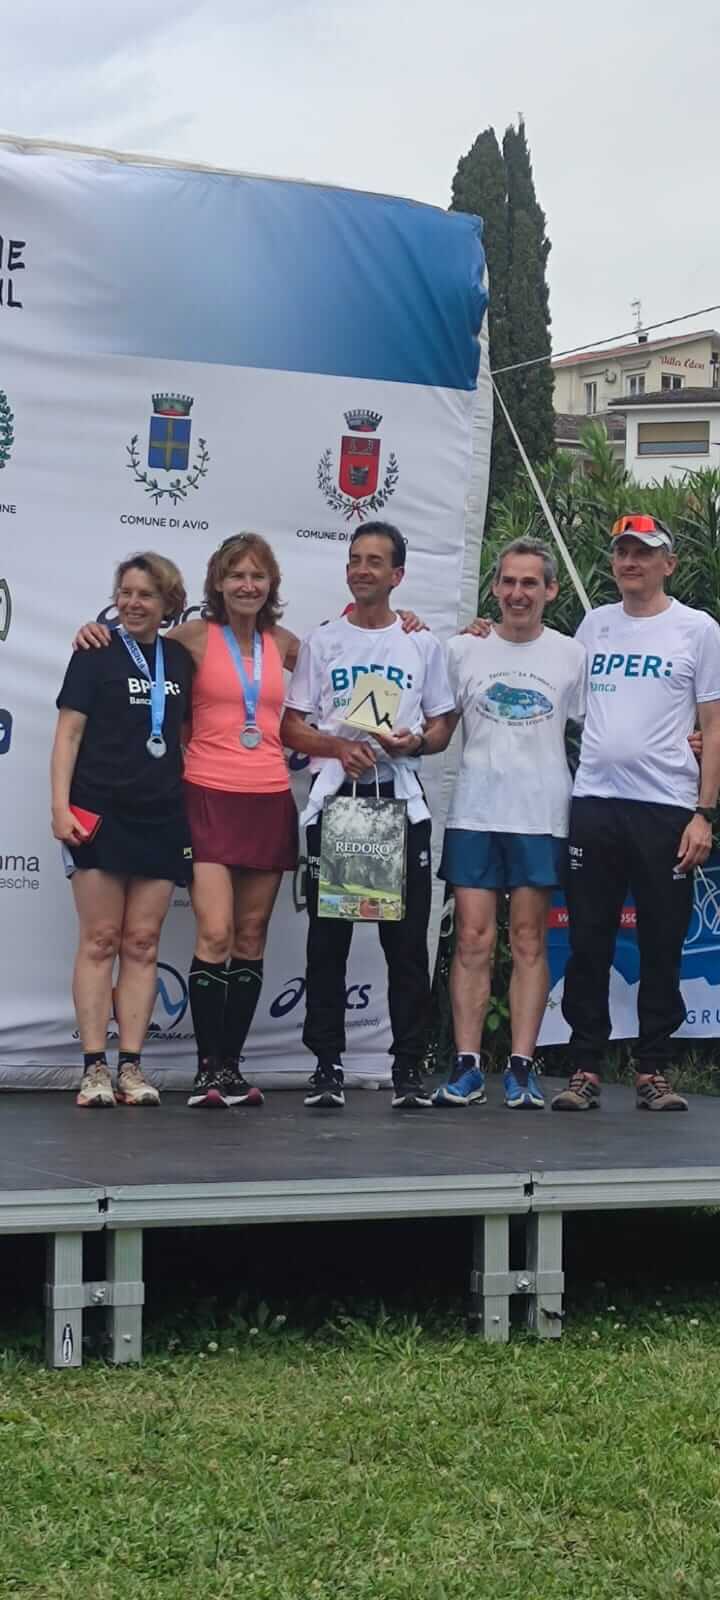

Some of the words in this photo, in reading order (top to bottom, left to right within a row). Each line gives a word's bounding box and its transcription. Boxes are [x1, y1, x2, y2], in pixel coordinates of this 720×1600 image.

[119, 514, 167, 528] COMUNE
[169, 518, 180, 528] DI
[182, 519, 209, 530] AVIO
[296, 529, 337, 541] COMUNE
[338, 532, 348, 541] DI
[590, 653, 673, 678] BPER:
[128, 678, 180, 695] BPR:
[129, 696, 152, 705] Banc
[335, 841, 391, 860] REDORO
[0, 855, 40, 872] ma
